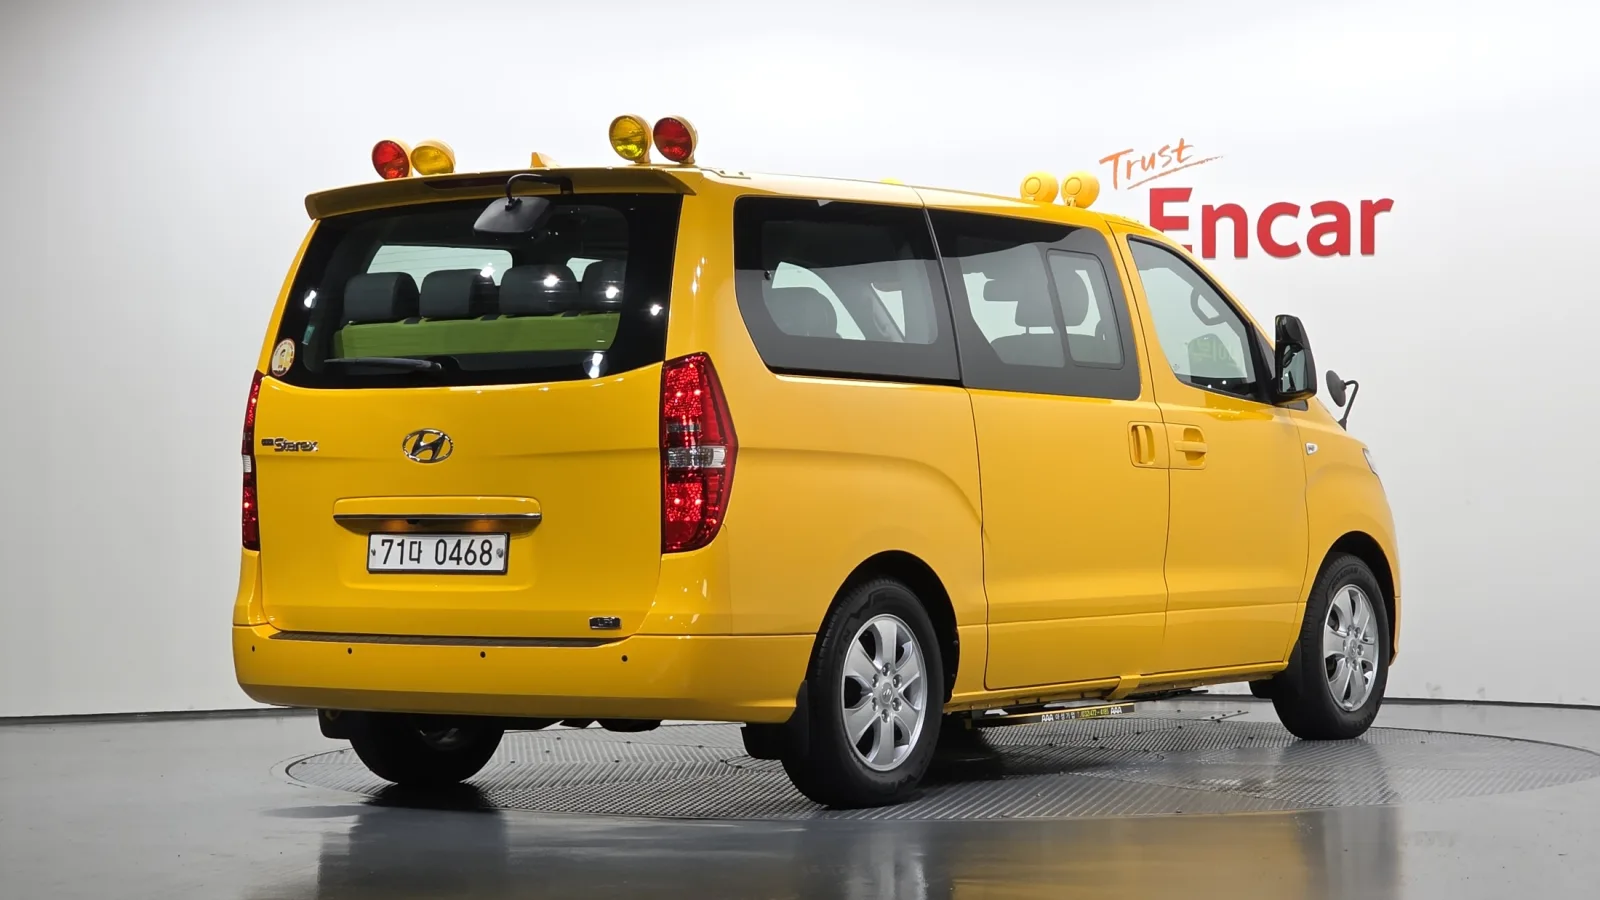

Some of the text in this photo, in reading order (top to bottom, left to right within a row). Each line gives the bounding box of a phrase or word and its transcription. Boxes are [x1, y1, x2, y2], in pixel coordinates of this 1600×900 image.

[1099, 138, 1194, 190] Trust
[1149, 187, 1394, 259] Encar
[274, 437, 319, 452] Starex
[381, 538, 493, 566] 71다 0468
